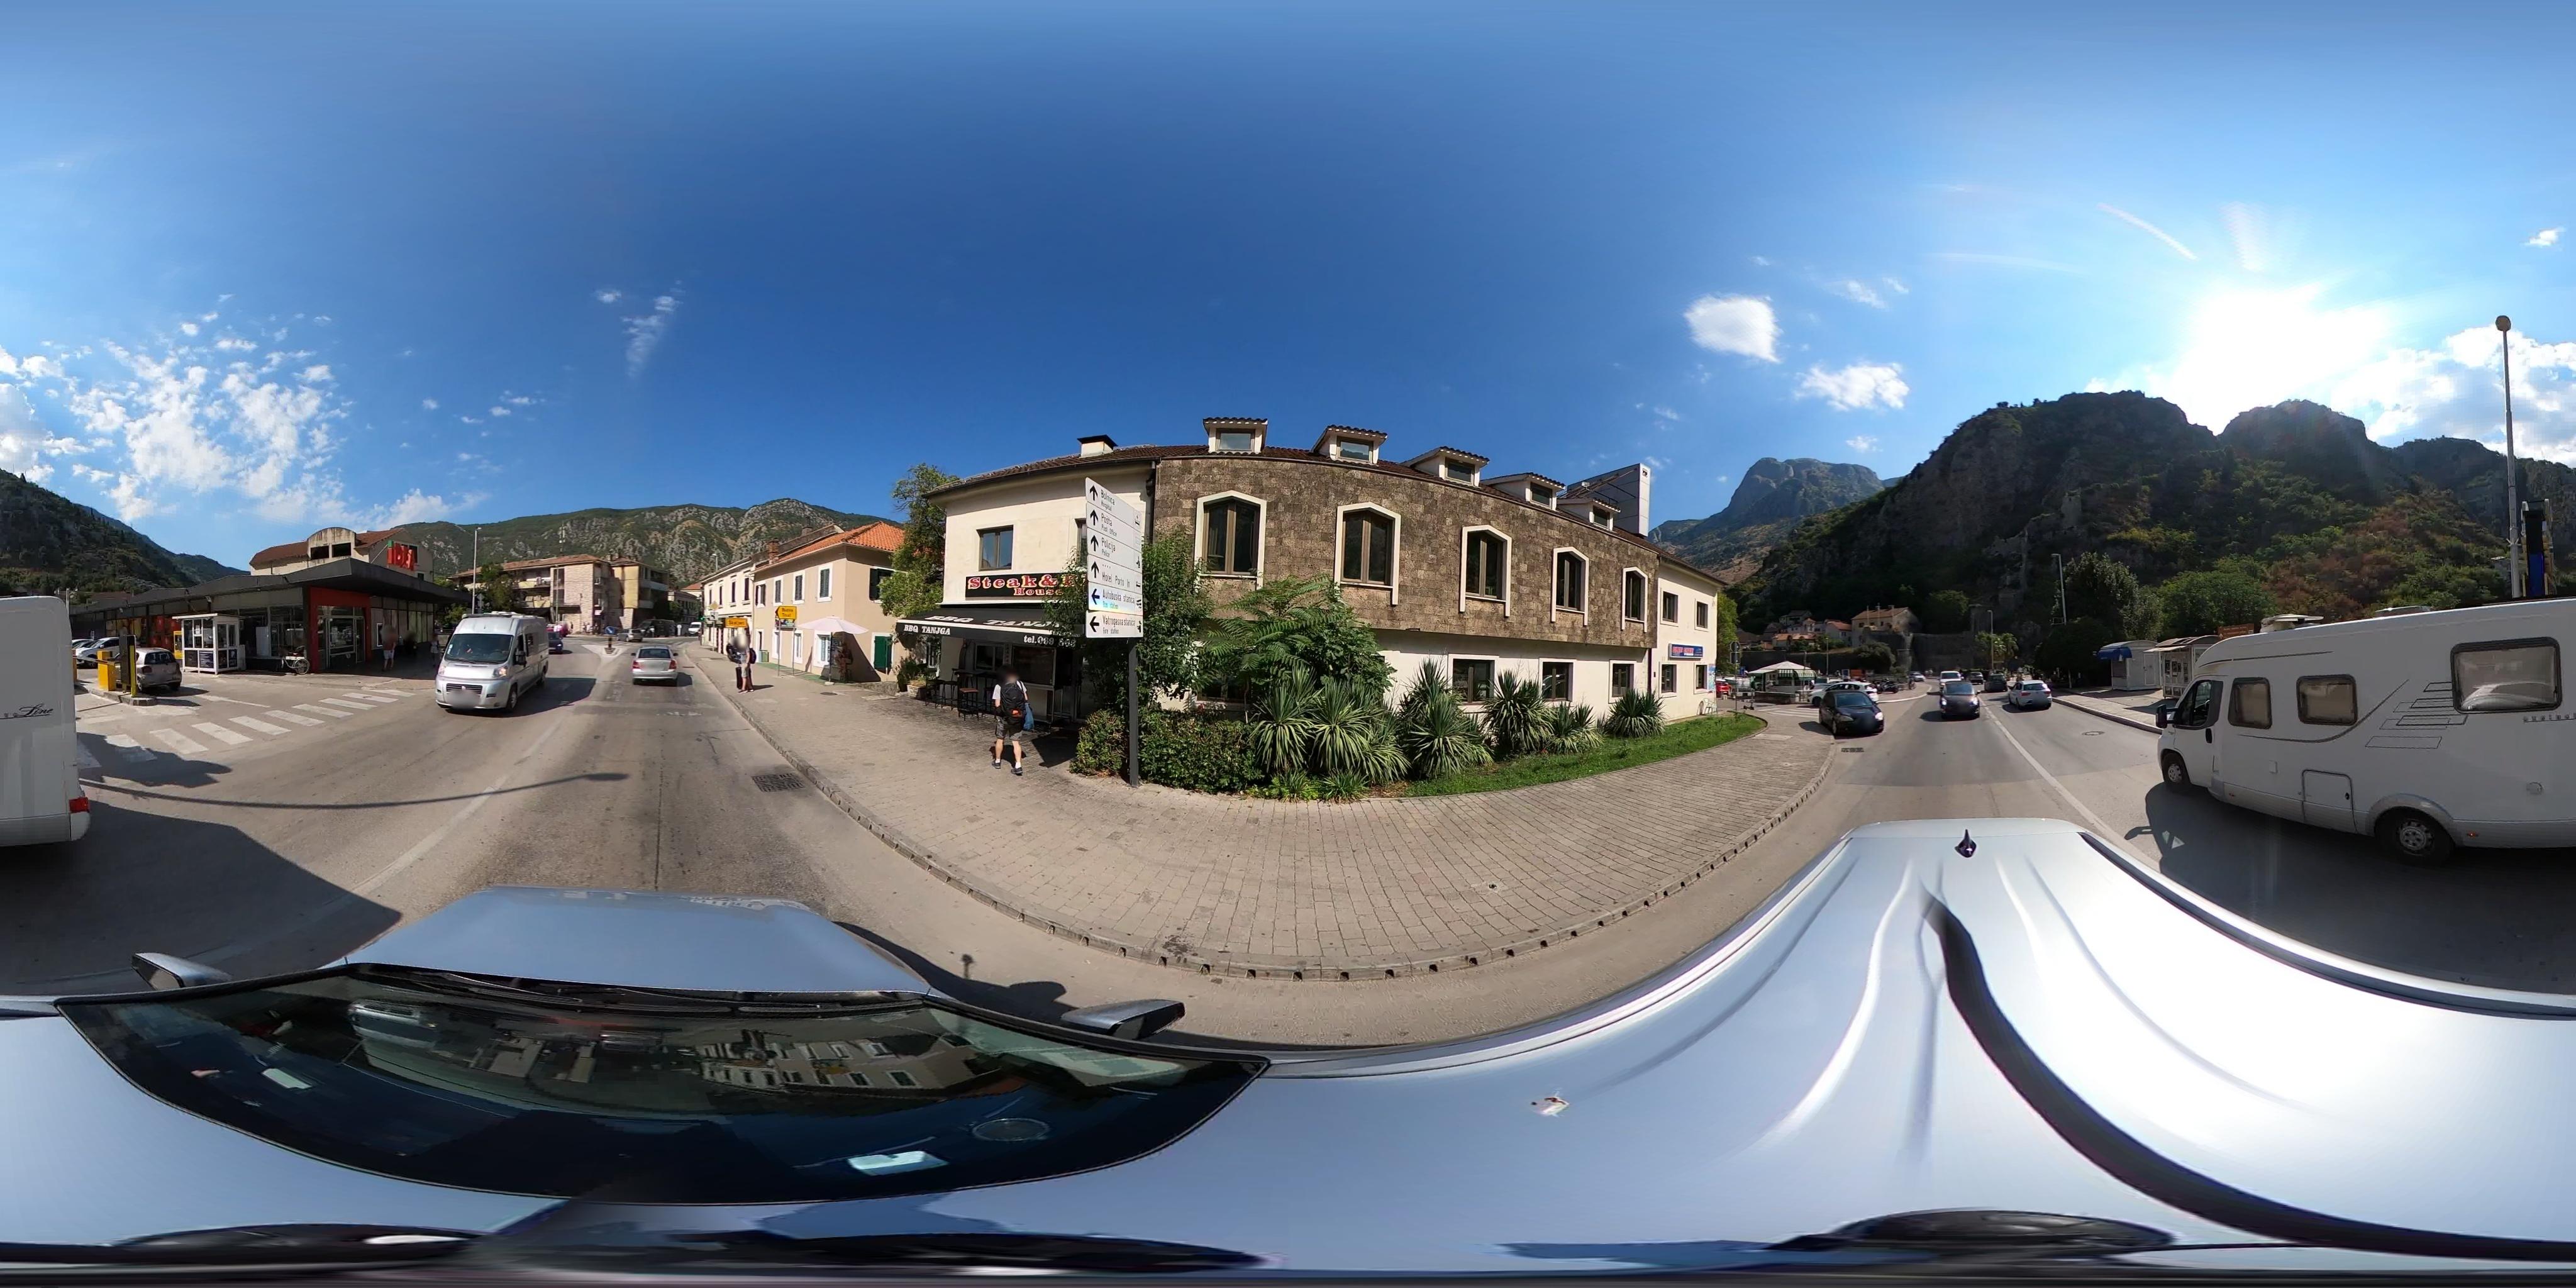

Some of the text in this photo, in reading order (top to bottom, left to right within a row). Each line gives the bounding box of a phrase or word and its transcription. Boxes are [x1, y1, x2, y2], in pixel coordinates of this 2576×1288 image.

[1101, 489, 1115, 505] Bolnica
[1101, 537, 1116, 553] Policija
[1102, 572, 1113, 583] Hotel
[1013, 587, 1064, 596] House
[1102, 589, 1135, 604] Autobuska stanica
[1102, 614, 1135, 628] Vatrogasna stanica
[903, 625, 950, 635] BBQ TANJGA
